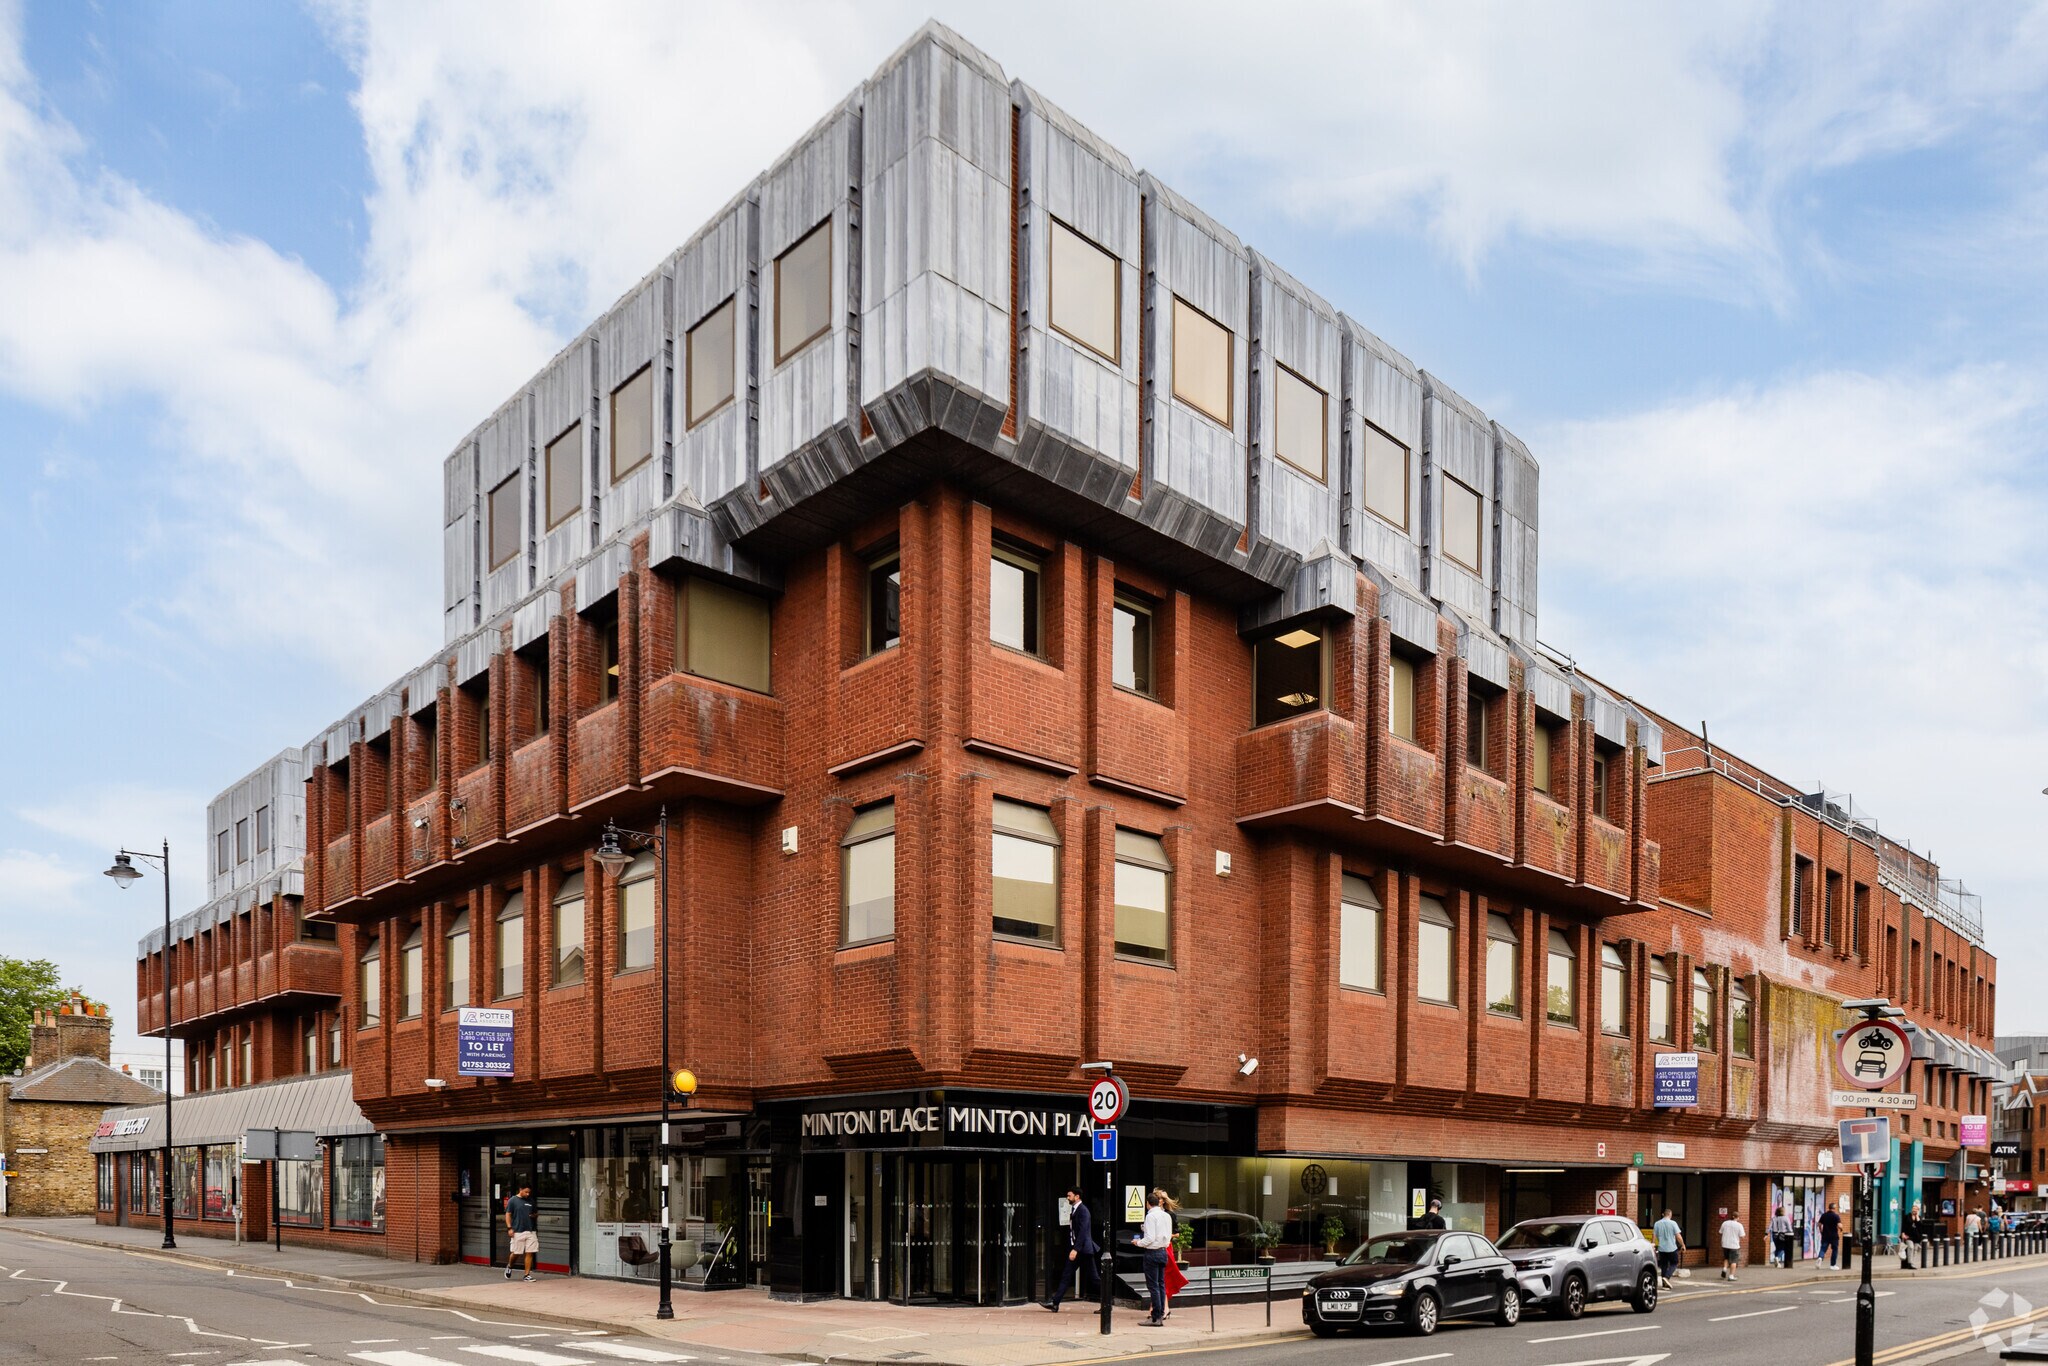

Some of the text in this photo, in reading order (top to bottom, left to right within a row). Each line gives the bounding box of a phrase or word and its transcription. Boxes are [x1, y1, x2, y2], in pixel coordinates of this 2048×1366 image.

[468, 1042, 504, 1051] TO LET
[1094, 1091, 1117, 1110] 20
[1878, 1096, 1900, 1104] 4.30
[802, 1106, 939, 1136] MINTON PLACE
[949, 1107, 1096, 1137] MINTON PLA
[1242, 1269, 1264, 1277] STREET
